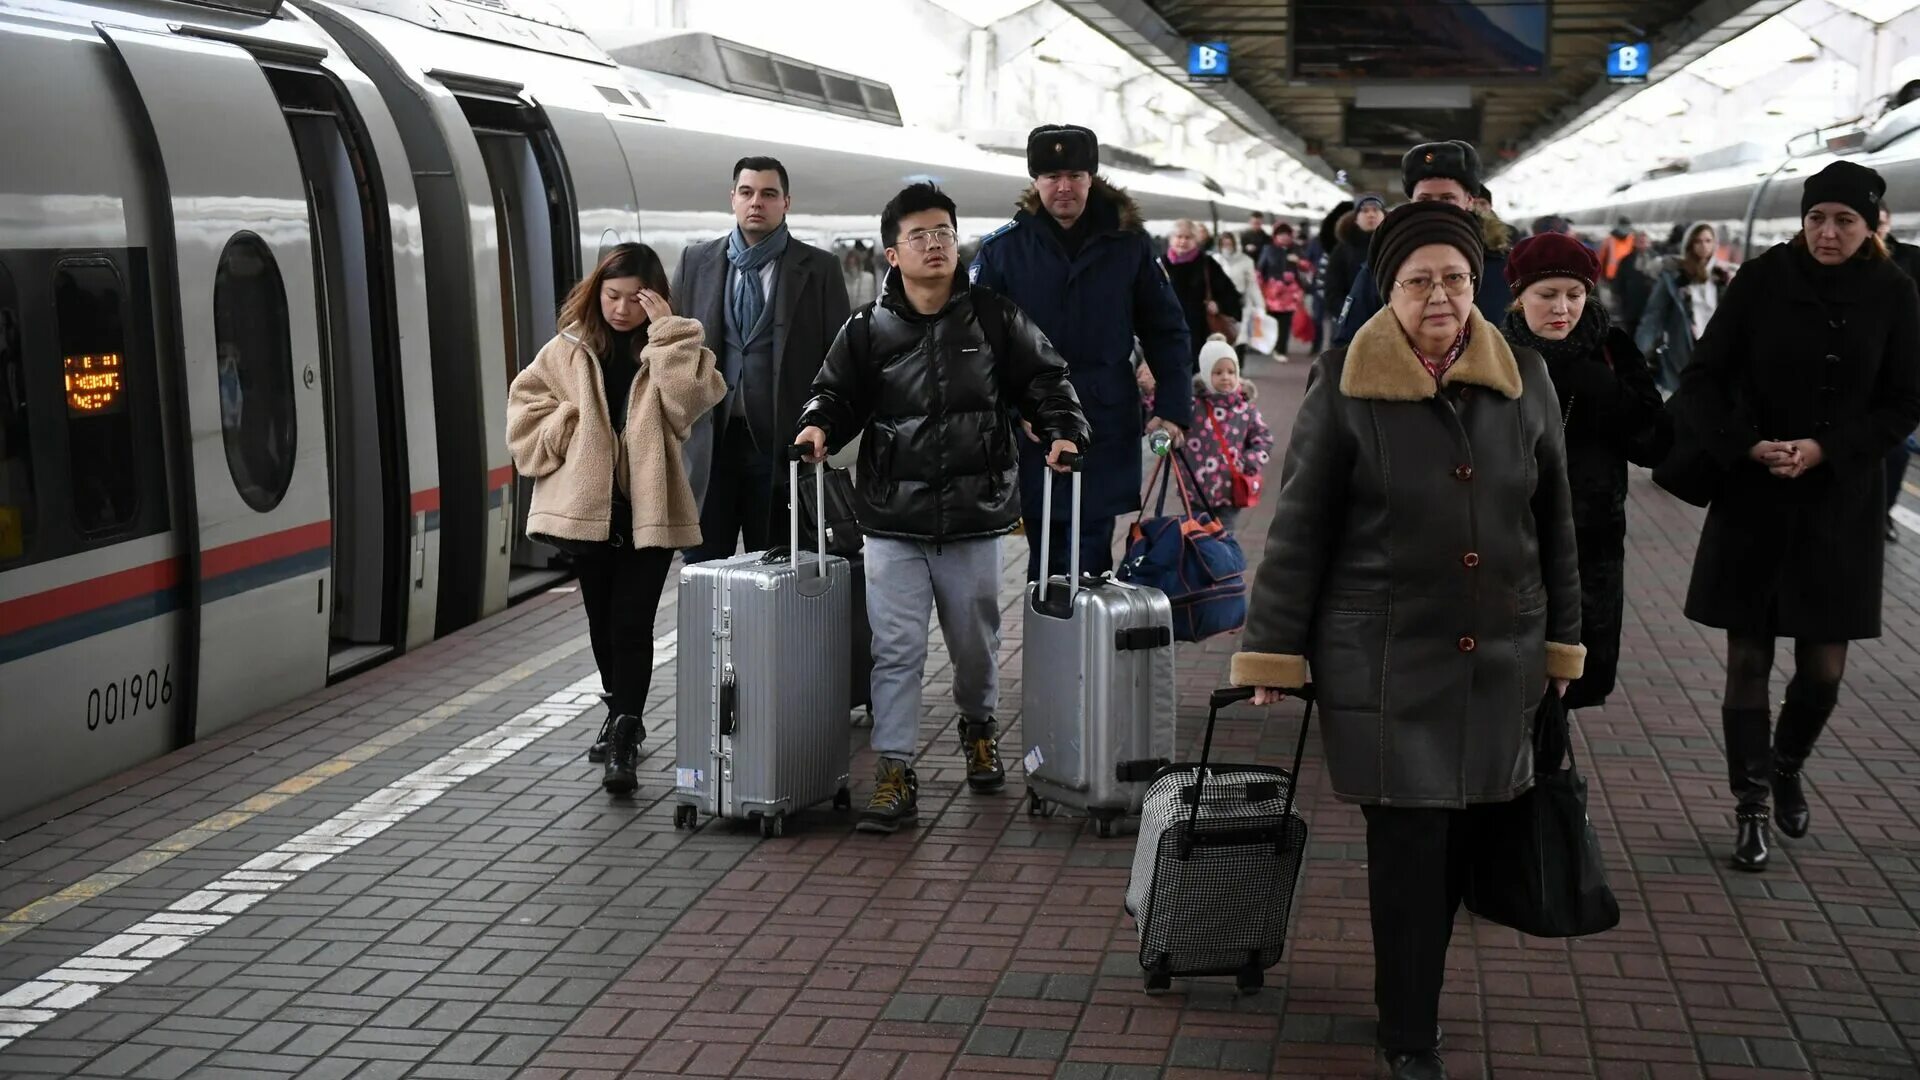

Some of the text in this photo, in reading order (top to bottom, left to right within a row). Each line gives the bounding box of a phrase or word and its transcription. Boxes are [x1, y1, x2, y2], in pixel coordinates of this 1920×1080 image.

[1199, 46, 1217, 70] B
[1619, 46, 1638, 71] B
[87, 663, 173, 731] 001906
